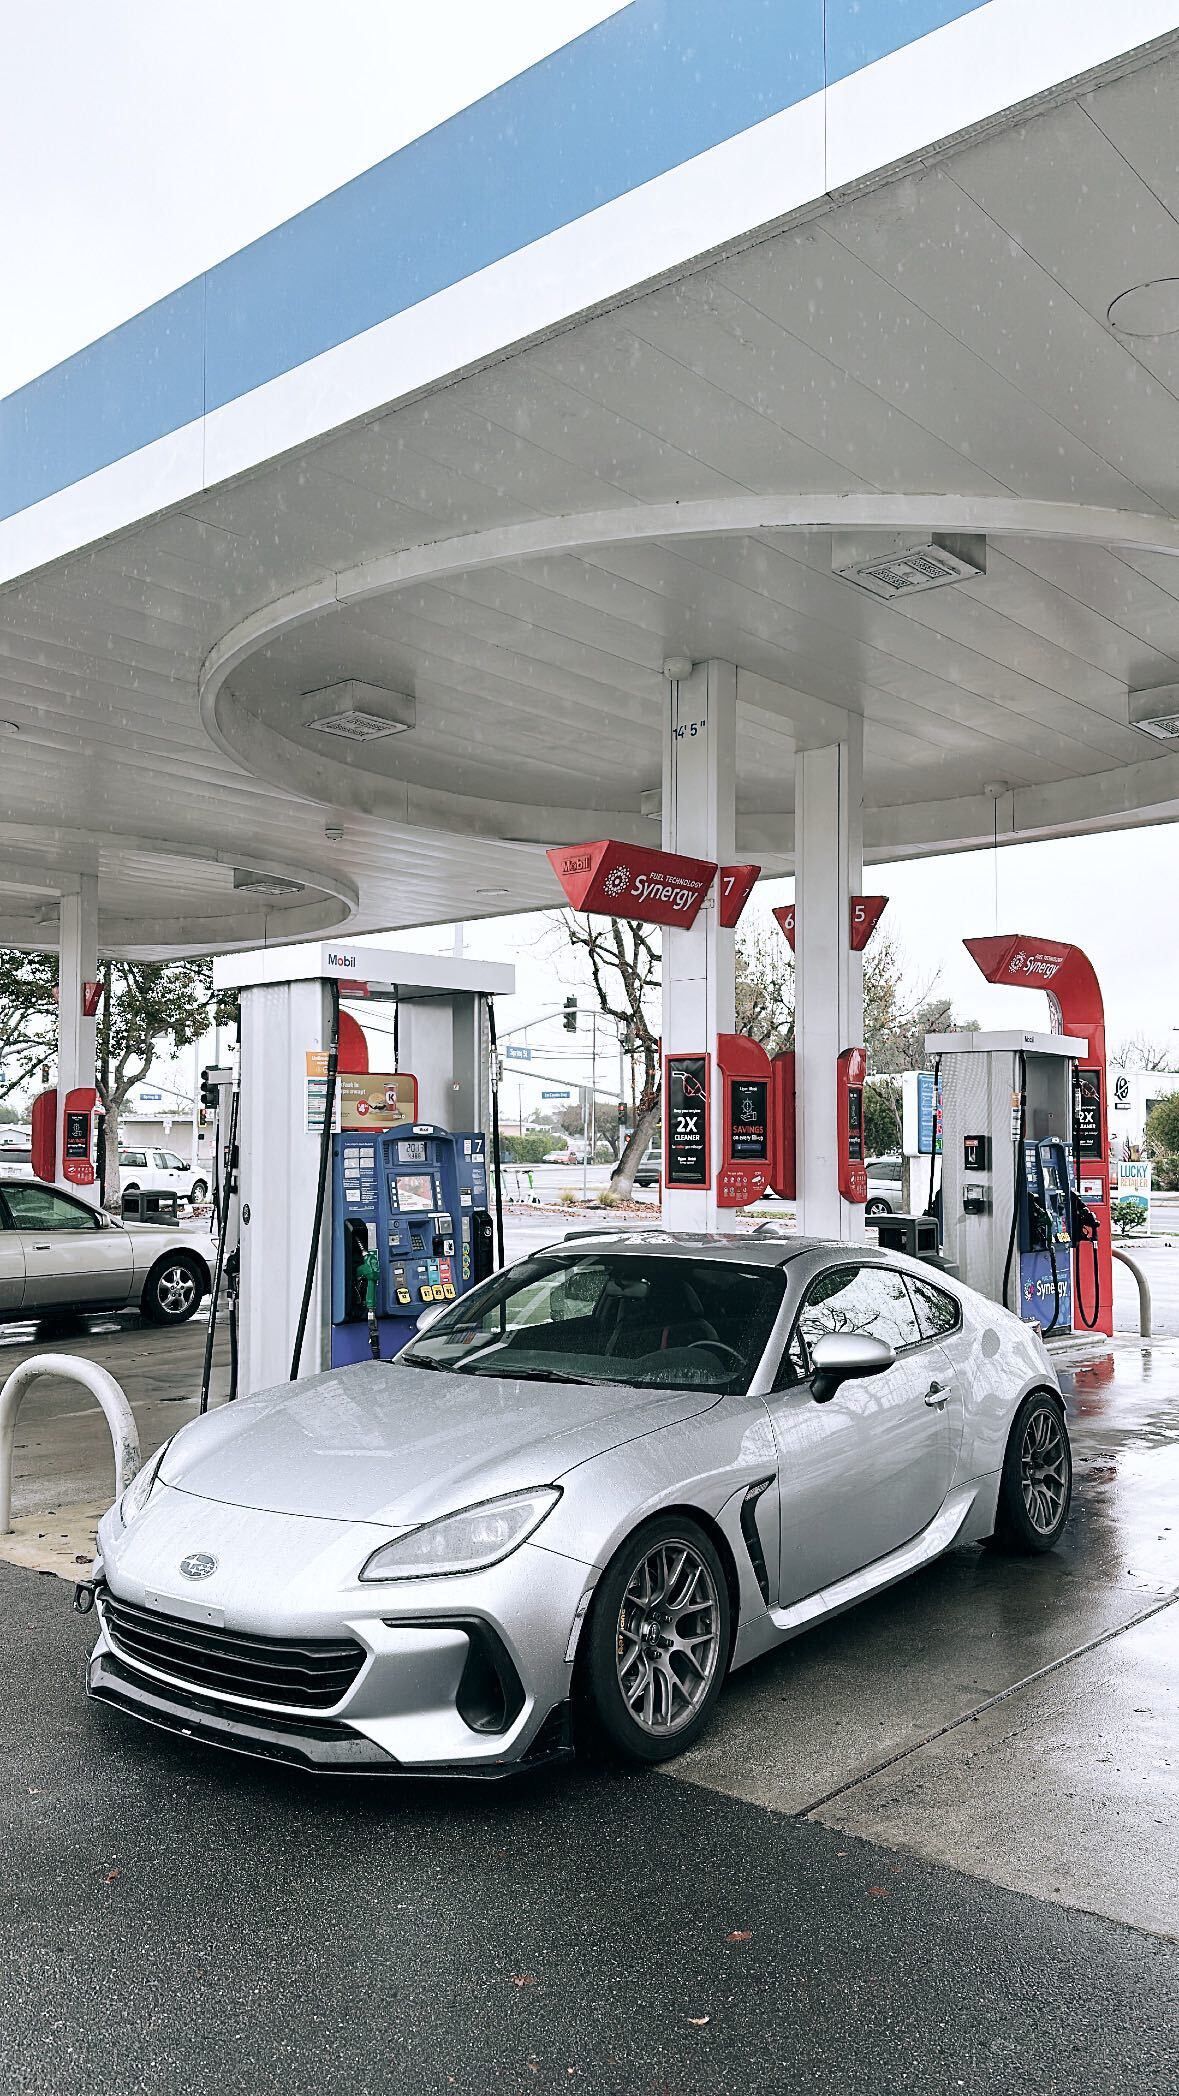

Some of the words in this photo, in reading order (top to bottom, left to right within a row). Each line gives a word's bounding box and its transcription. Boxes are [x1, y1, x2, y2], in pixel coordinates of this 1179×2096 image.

[562, 856, 591, 873] Mobil
[649, 871, 664, 882] FUEL
[665, 875, 704, 888] TECHNOLOGY
[723, 877, 736, 896] 7
[631, 875, 699, 911] Synergy
[784, 913, 795, 929] 6
[854, 905, 866, 922] 5
[328, 953, 356, 968] Mobil
[1023, 956, 1060, 979] Synergy
[388, 1093, 394, 1102] K
[676, 1116, 698, 1132] 2X
[733, 1125, 764, 1134] SAVINGS
[474, 1139, 483, 1153] 7
[1120, 1164, 1148, 1178] LUCKY
[1120, 1177, 1149, 1188] RETAILER
[1036, 1279, 1068, 1300] Synegy
